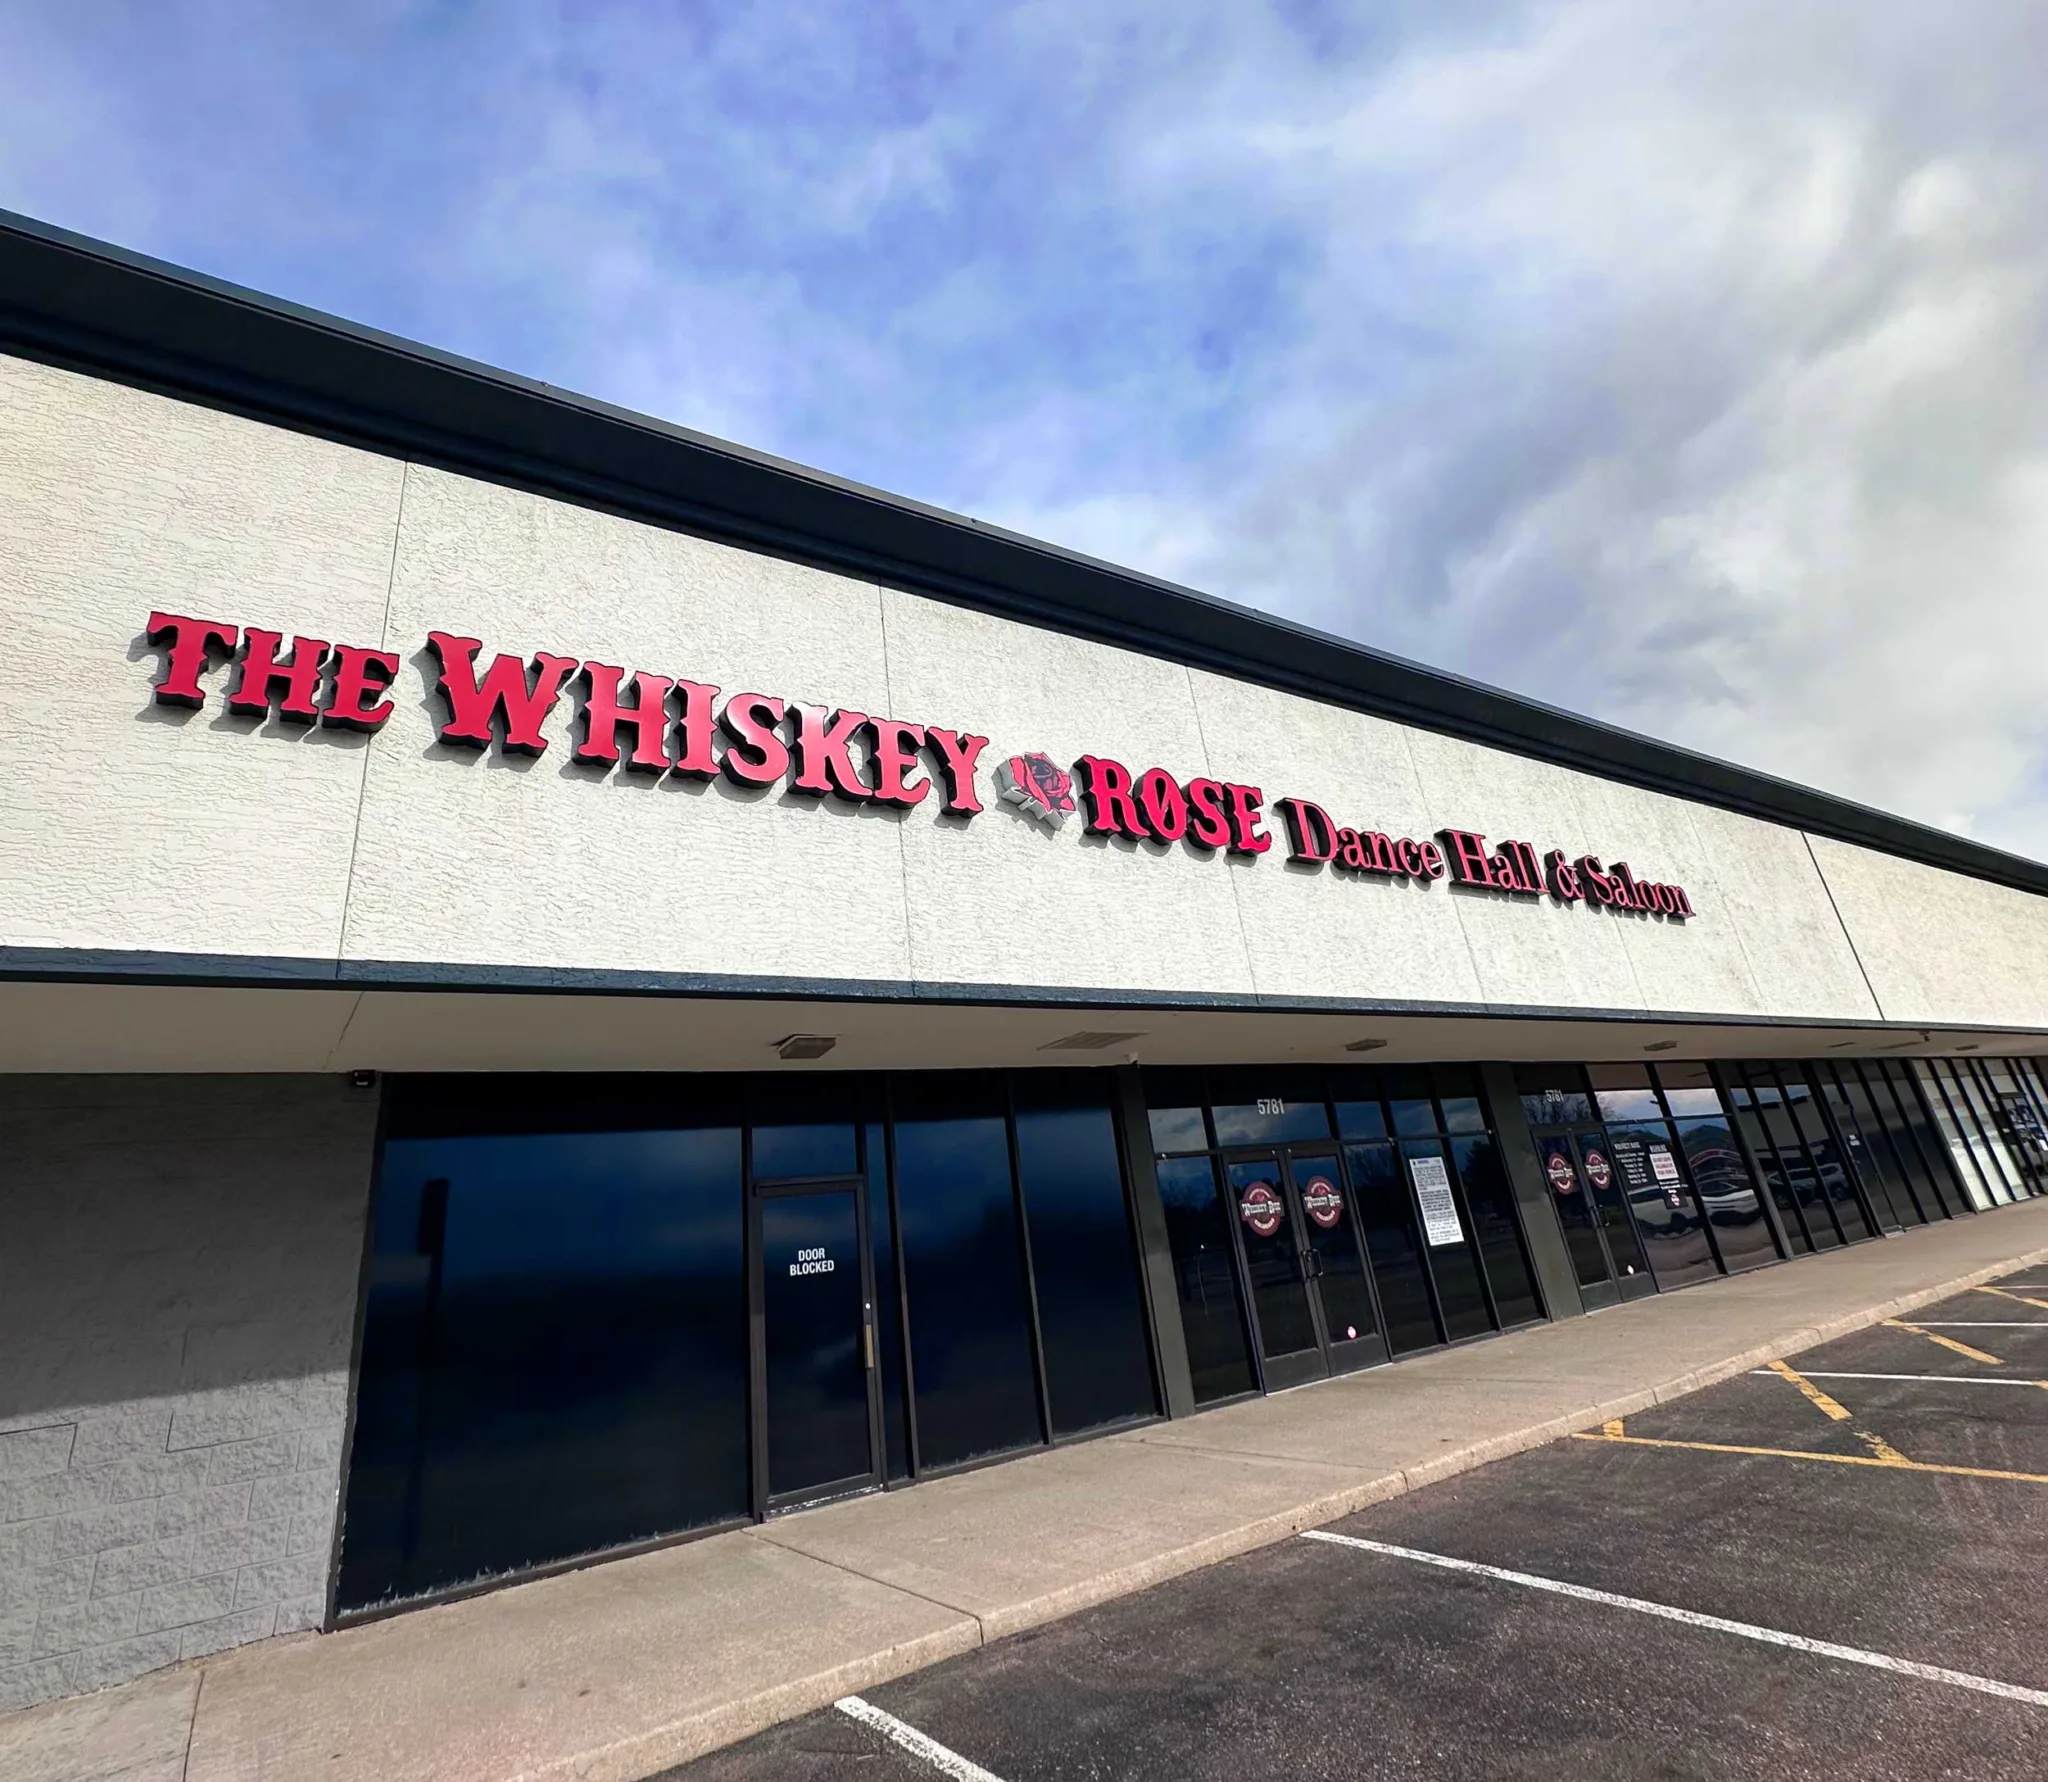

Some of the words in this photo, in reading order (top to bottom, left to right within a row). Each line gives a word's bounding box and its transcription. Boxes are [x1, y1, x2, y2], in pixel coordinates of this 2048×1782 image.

[147, 611, 399, 727] THE
[427, 631, 989, 815] WHISKEY
[1282, 798, 1444, 880] Dance
[1443, 829, 1549, 896] Hall
[1550, 849, 1584, 900] &
[1580, 855, 1696, 918] Saloon
[1257, 1098, 1285, 1115] 5781
[798, 1248, 825, 1261] DOOR
[789, 1260, 835, 1276] BLOCKED
